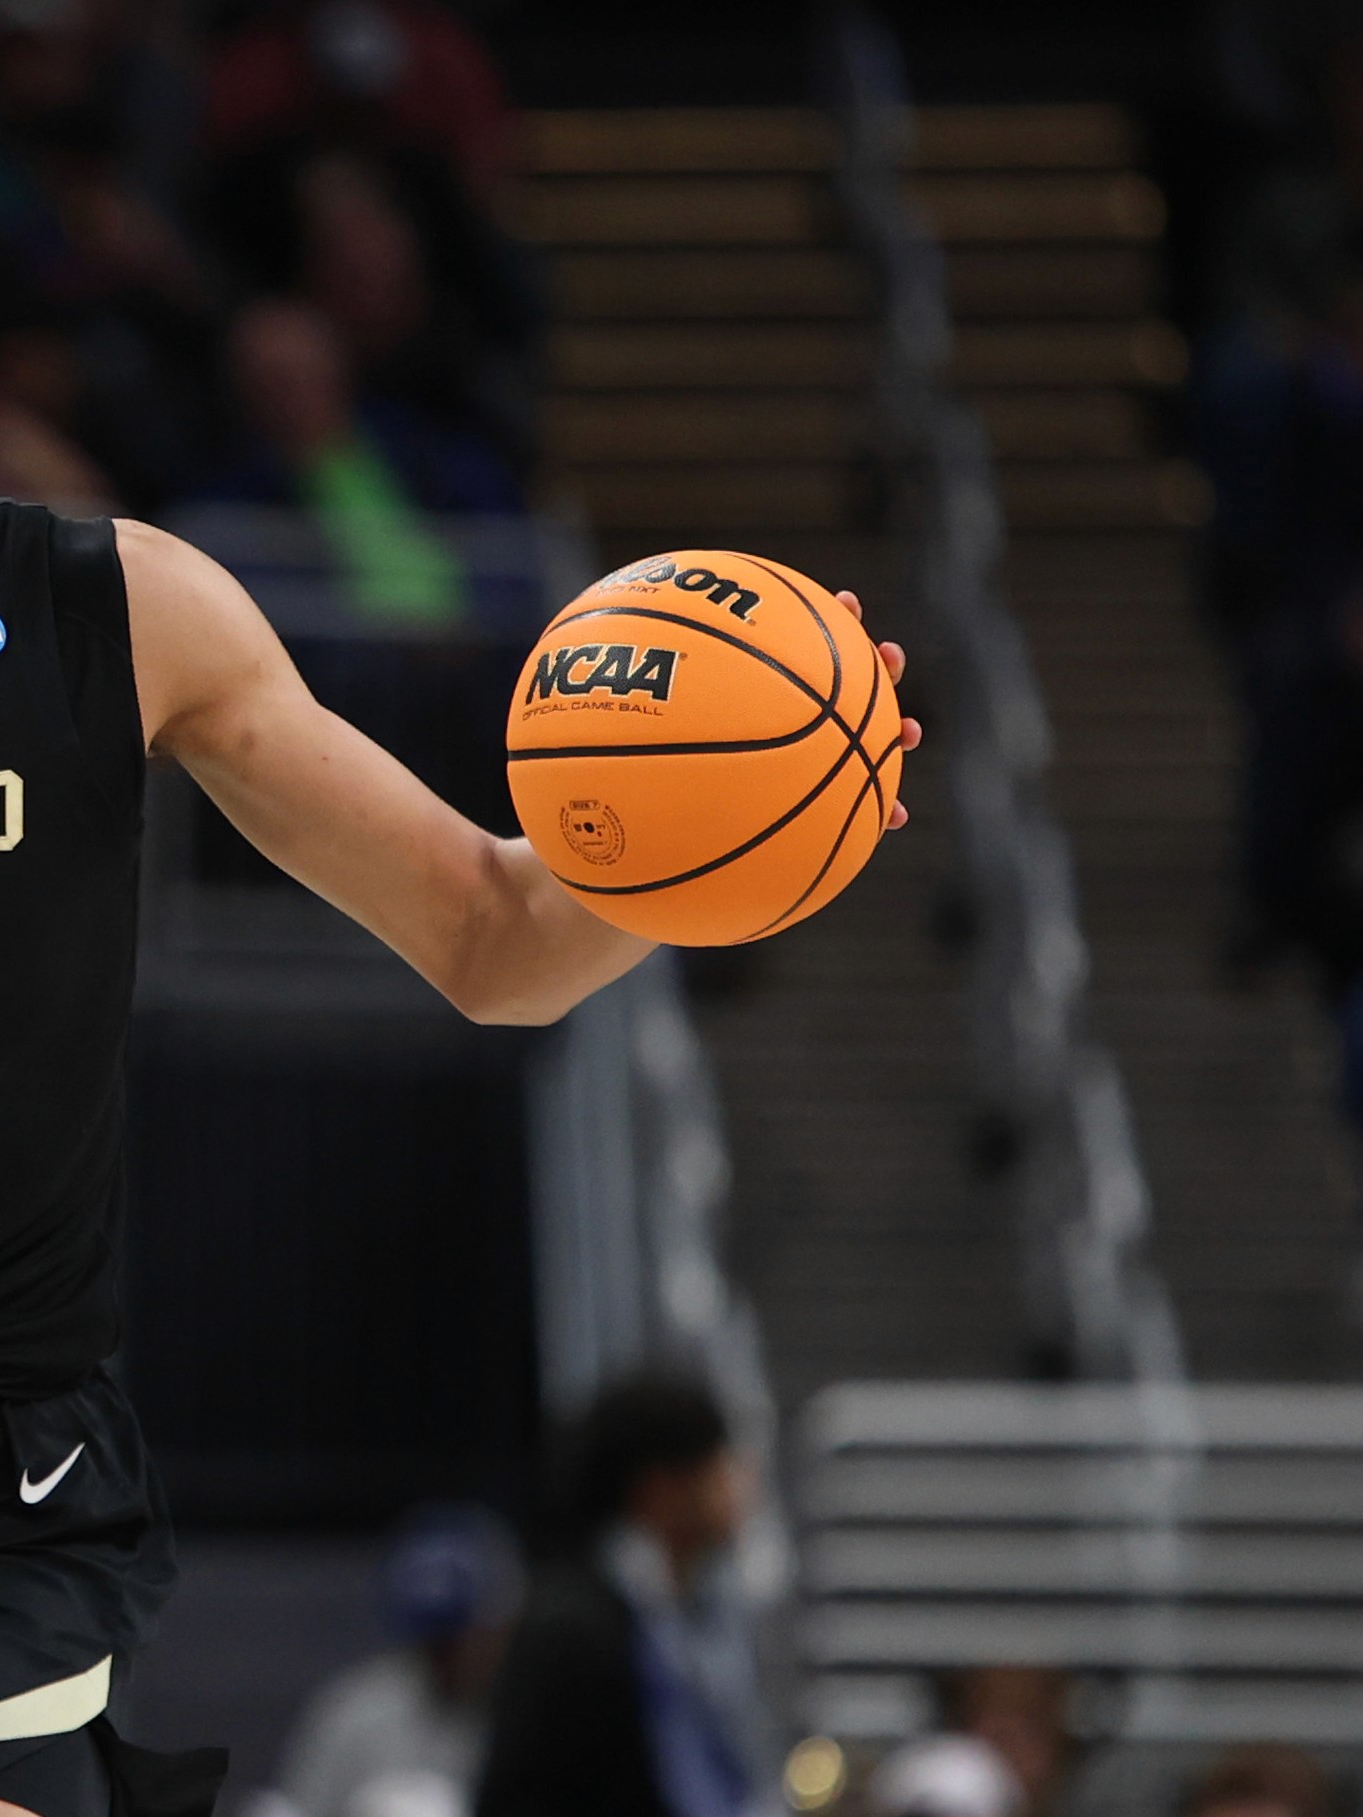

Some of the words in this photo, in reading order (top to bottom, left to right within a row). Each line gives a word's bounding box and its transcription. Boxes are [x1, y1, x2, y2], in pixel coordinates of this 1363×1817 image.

[588, 556, 760, 621] lson
[524, 643, 679, 706] NCAA
[571, 701, 614, 711] GAME
[619, 702, 664, 717] BALL
